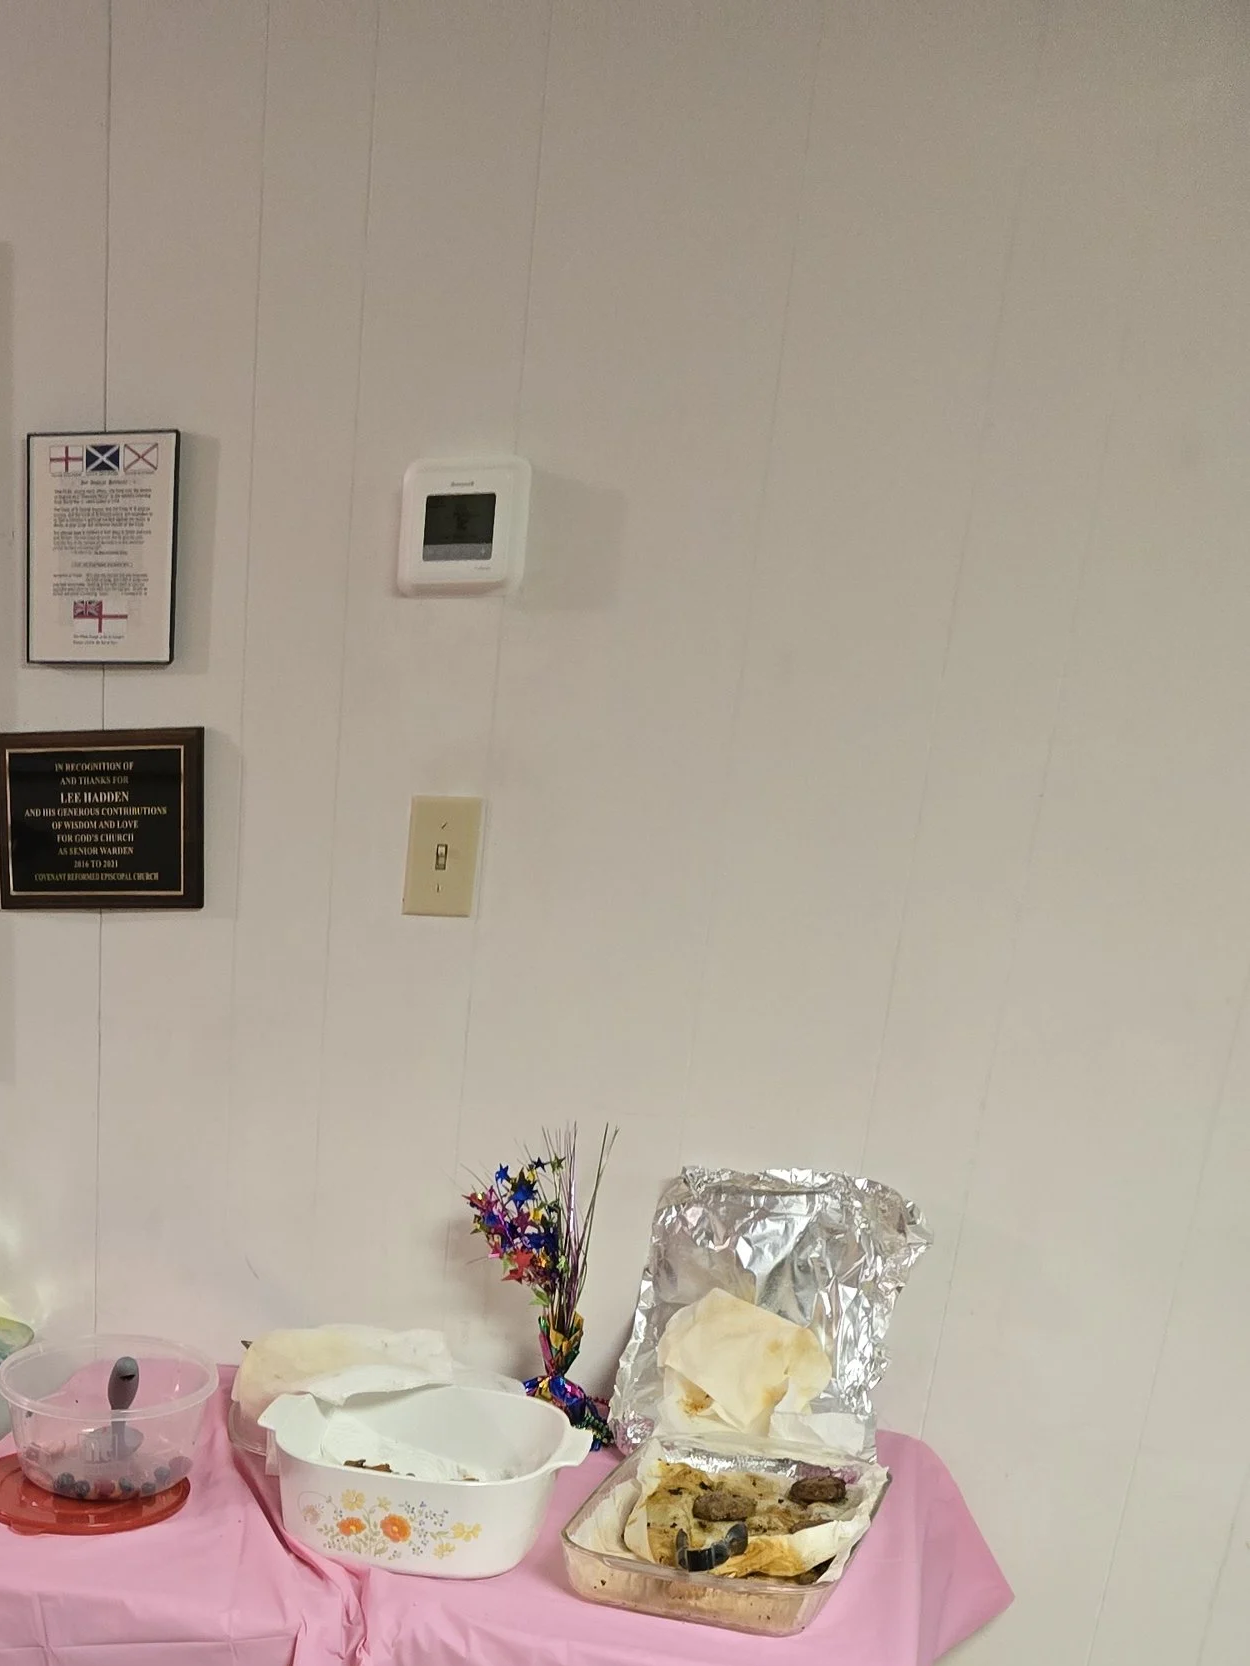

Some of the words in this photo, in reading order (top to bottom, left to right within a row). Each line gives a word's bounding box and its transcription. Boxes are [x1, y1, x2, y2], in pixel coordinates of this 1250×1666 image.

[54, 763, 64, 772] IN
[65, 761, 121, 771] RECOGNITION
[122, 761, 134, 770] OF
[60, 776, 77, 786] AND
[78, 775, 111, 785] THANKS
[112, 775, 129, 784] FOR
[60, 792, 81, 804] LEE
[83, 791, 129, 803] HADDEN
[24, 808, 41, 817] AND
[42, 808, 56, 817] HIS
[57, 807, 100, 816] GENEROUS
[101, 806, 167, 816] CONTRIBUTIONS
[51, 821, 63, 830] OF
[63, 820, 97, 830] WISDOM
[98, 820, 116, 829] AND
[116, 820, 139, 829] LOVE
[56, 834, 73, 843] FOR
[100, 833, 134, 842] CHURCH
[58, 847, 69, 856] AS
[69, 847, 99, 856] SENIOR
[99, 846, 134, 856] WARDEN
[90, 860, 102, 868] TO
[34, 872, 67, 881] COVENANT
[67, 872, 100, 881] REFORMED
[100, 872, 133, 881] EPISCOPAL
[133, 872, 159, 881] CHURCH
